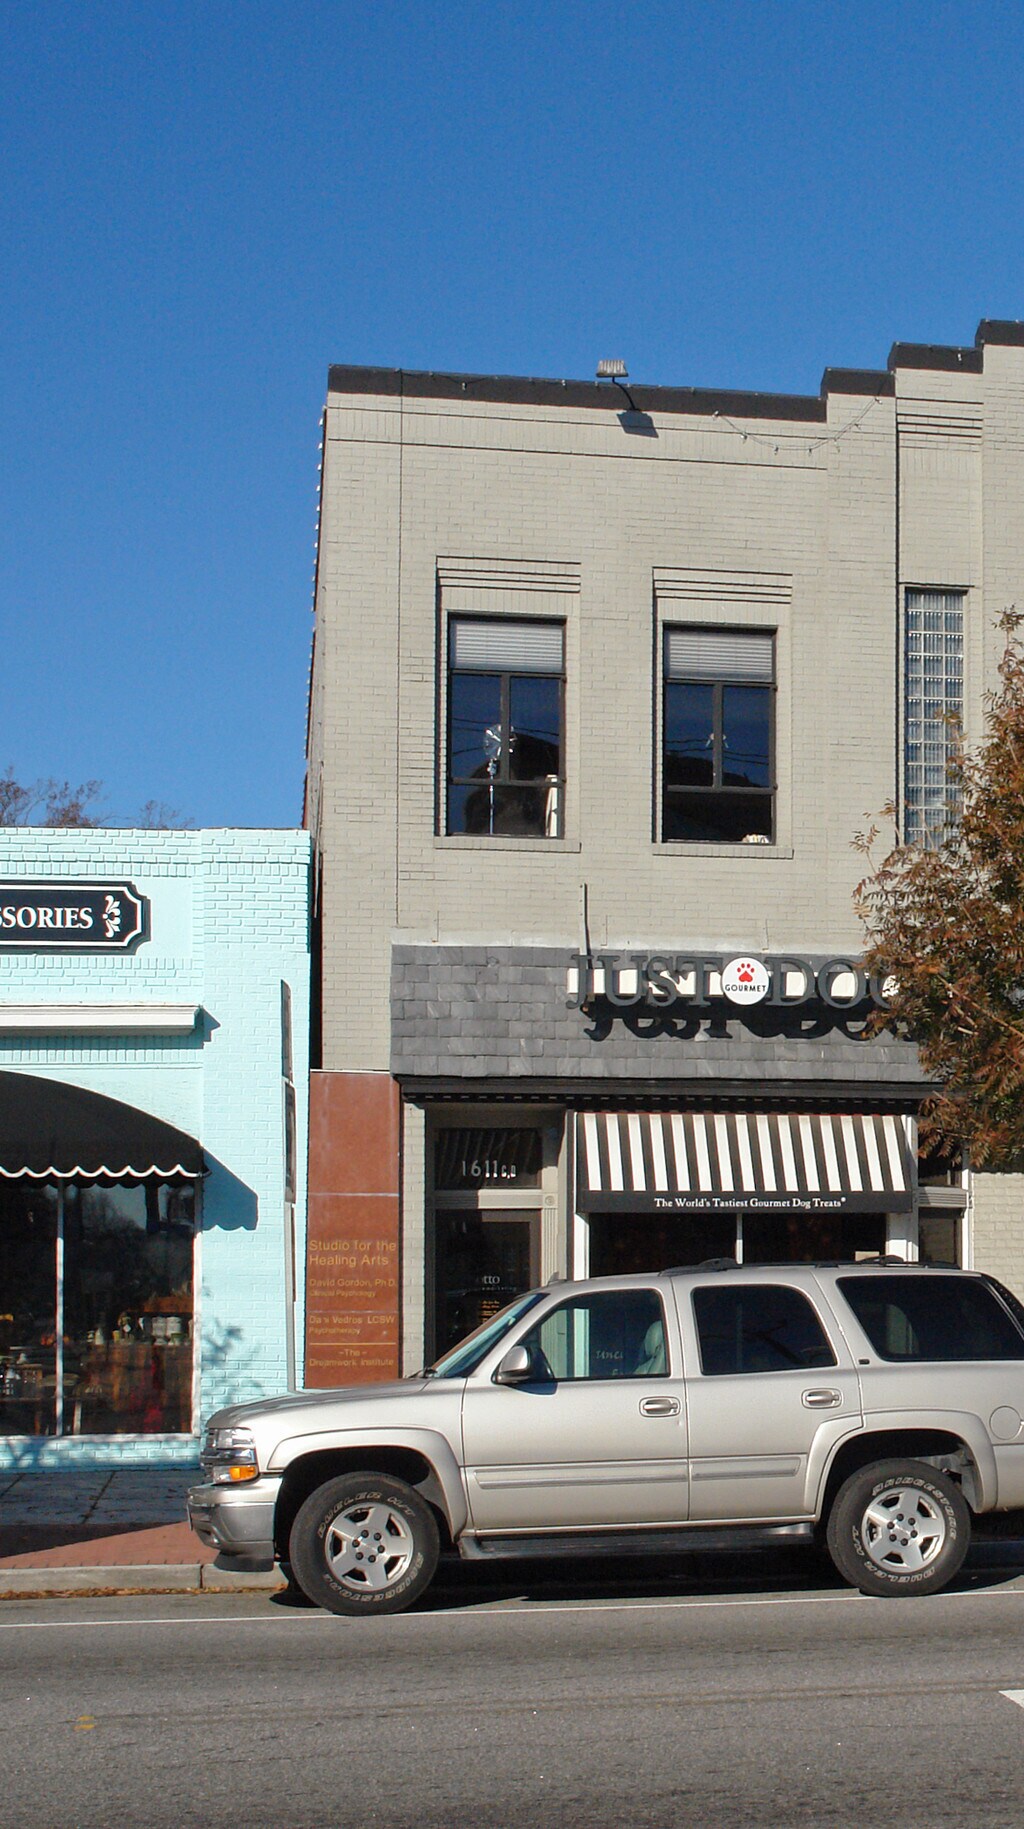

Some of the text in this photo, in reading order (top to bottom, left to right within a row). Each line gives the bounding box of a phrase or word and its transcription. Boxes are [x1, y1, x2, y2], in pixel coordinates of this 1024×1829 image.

[0, 906, 94, 929] SORIES
[566, 955, 724, 1009] JUST
[725, 983, 767, 993] GOURMET
[654, 1197, 673, 1207] The
[675, 1197, 711, 1207] World's
[712, 1197, 748, 1207] Tastiest
[750, 1197, 790, 1207] Gourmet
[792, 1197, 811, 1209] Dog
[309, 1240, 397, 1251] Studio for the
[309, 1255, 389, 1268] Healing Arts
[309, 1279, 335, 1287] David
[367, 1315, 395, 1324] LCSW
